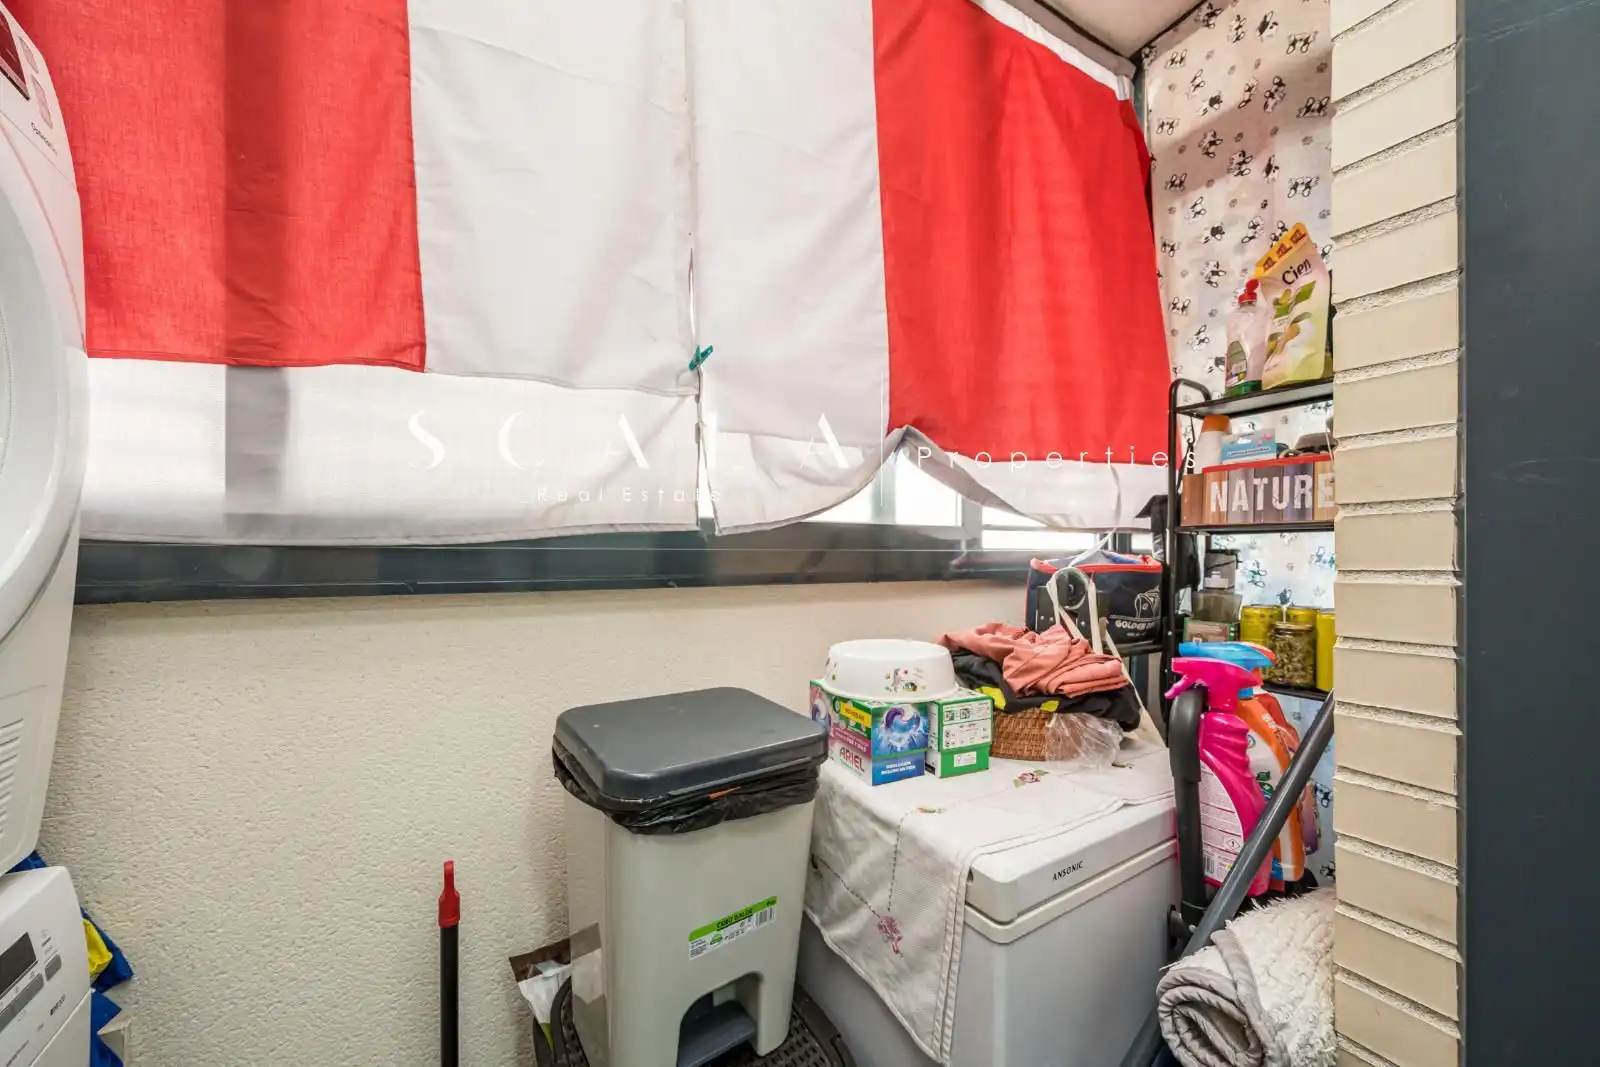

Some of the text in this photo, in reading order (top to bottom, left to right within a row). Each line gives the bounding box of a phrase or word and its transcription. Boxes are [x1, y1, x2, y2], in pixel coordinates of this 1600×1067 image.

[1282, 258, 1312, 285] Cien
[1210, 472, 1335, 513] NATURE
[840, 747, 865, 772] ARIEL
[1052, 860, 1084, 881] ANSONIC
